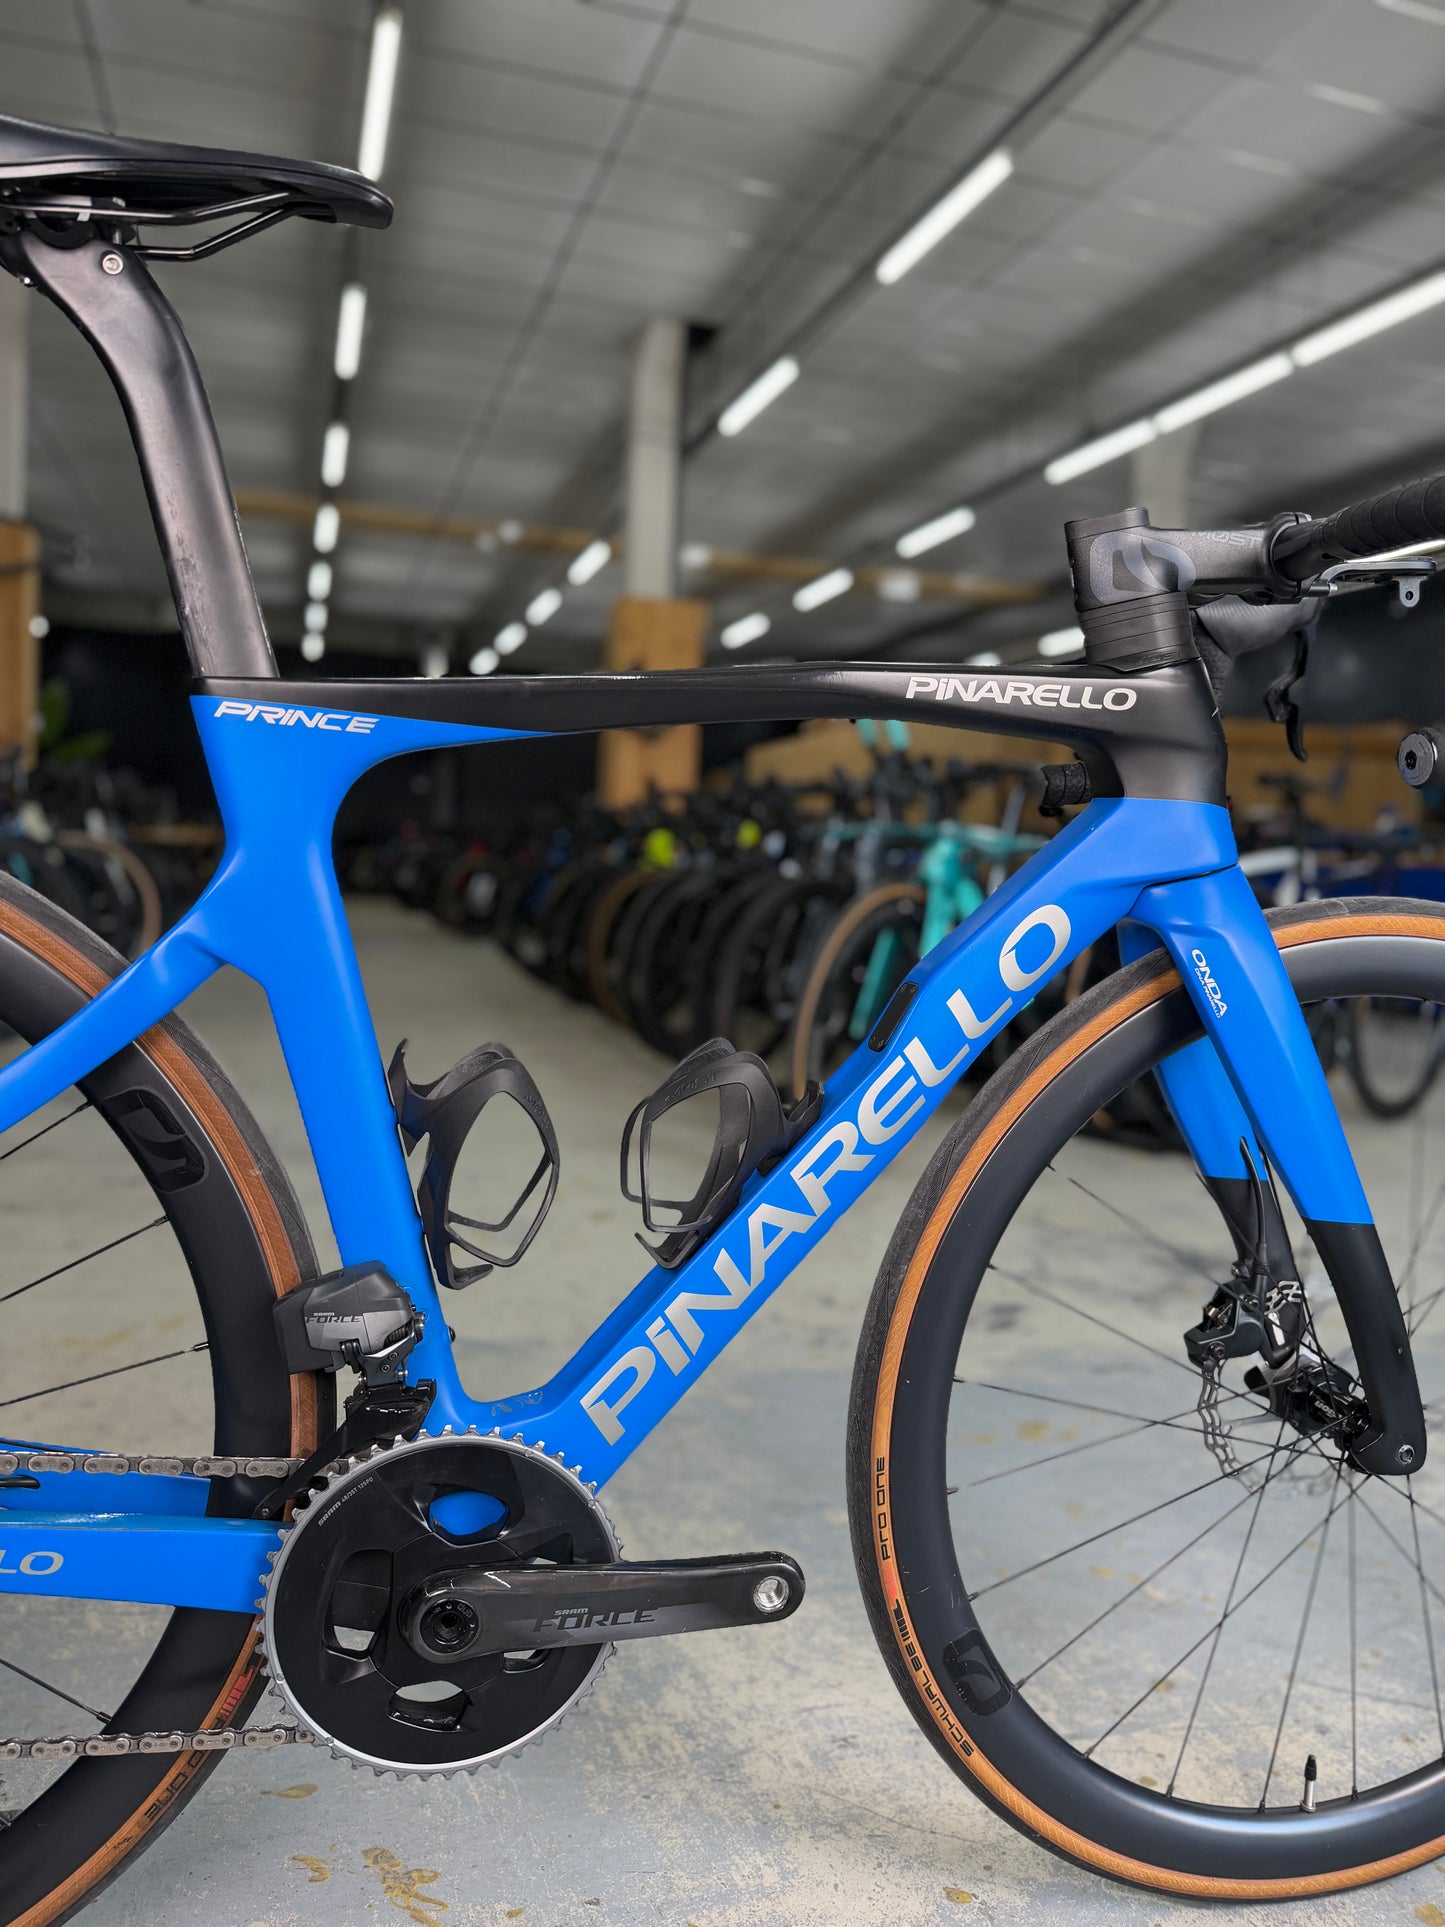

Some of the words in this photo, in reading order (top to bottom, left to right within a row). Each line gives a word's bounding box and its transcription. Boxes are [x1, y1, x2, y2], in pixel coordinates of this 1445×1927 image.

[1191, 949, 1228, 1017] ONDA
[304, 1315, 362, 1324] FORCE
[876, 1457, 885, 1507] ONE
[318, 1501, 341, 1527] SRAM
[878, 1512, 890, 1561] PRO
[532, 1609, 656, 1633] FORCE
[554, 1607, 589, 1616] SRAM
[905, 1641, 974, 1757] SCHWALBE
